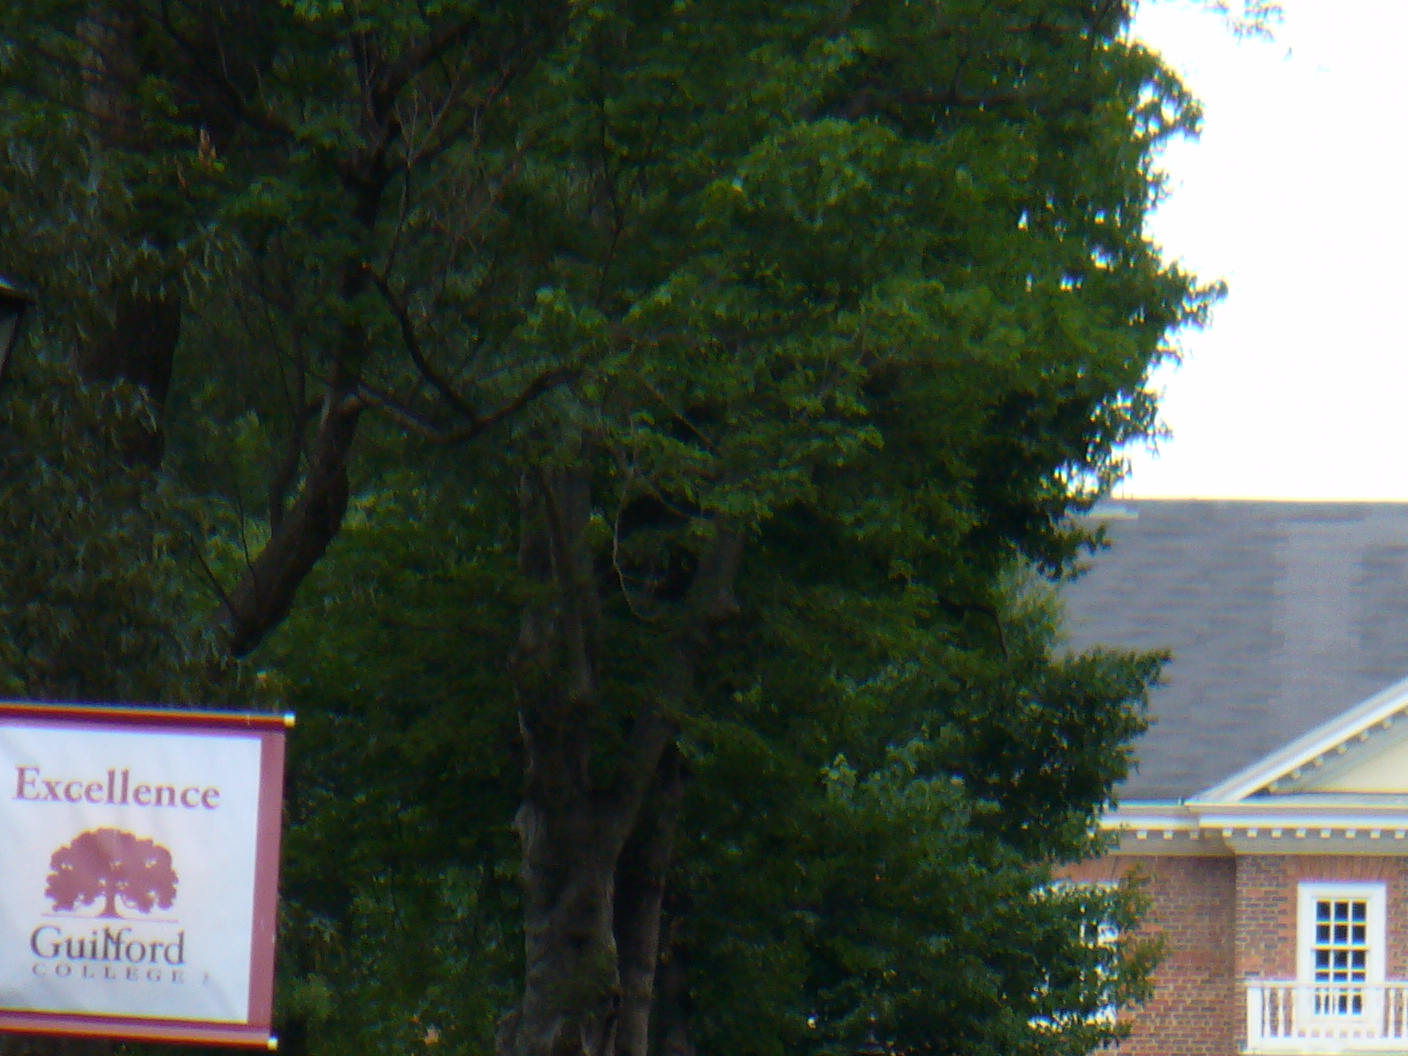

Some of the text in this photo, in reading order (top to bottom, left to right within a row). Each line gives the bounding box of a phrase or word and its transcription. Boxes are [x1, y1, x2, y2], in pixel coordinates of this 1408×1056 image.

[15, 765, 221, 810] Excellence
[30, 925, 186, 965] Guilford
[32, 963, 185, 984] COLLEGE
